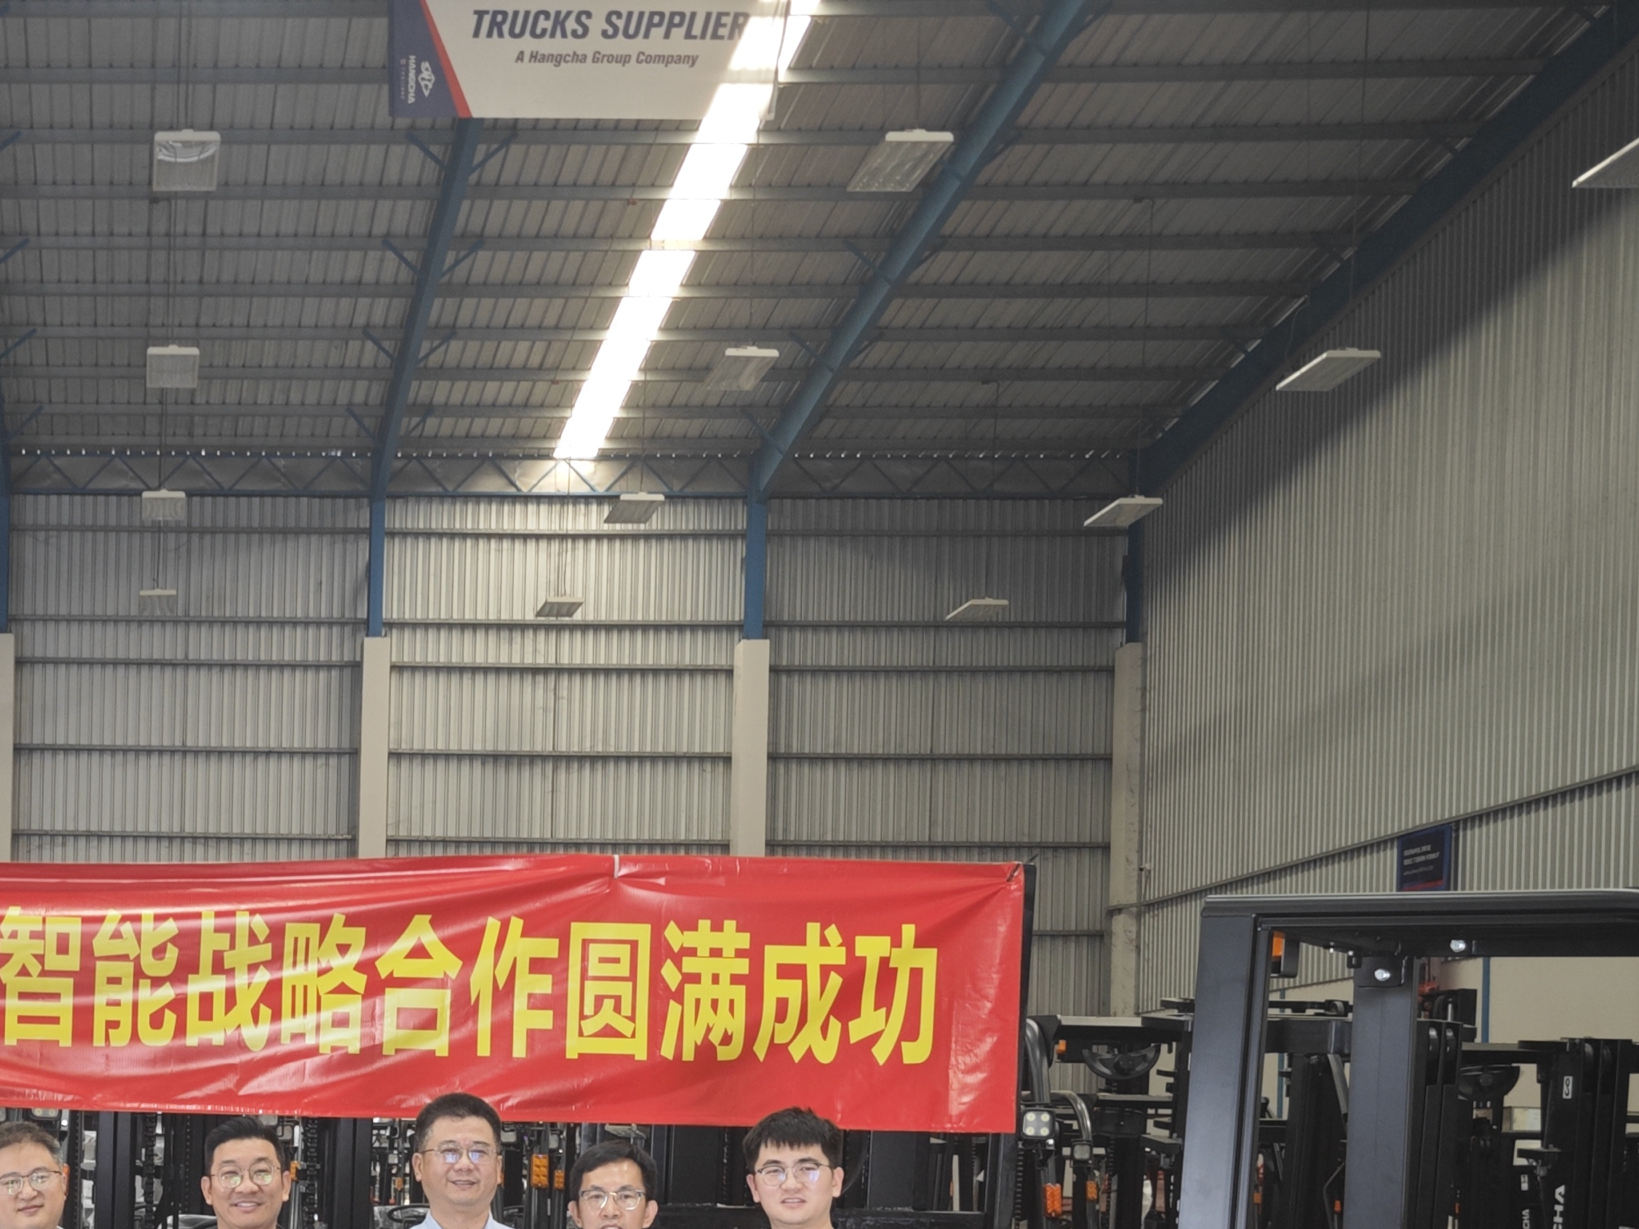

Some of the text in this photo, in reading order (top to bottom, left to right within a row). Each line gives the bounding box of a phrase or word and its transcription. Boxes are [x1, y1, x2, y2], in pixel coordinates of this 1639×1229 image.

[471, 9, 751, 41] TRUCKS SUPPLIER
[515, 51, 699, 67] A Hangcha Group Company
